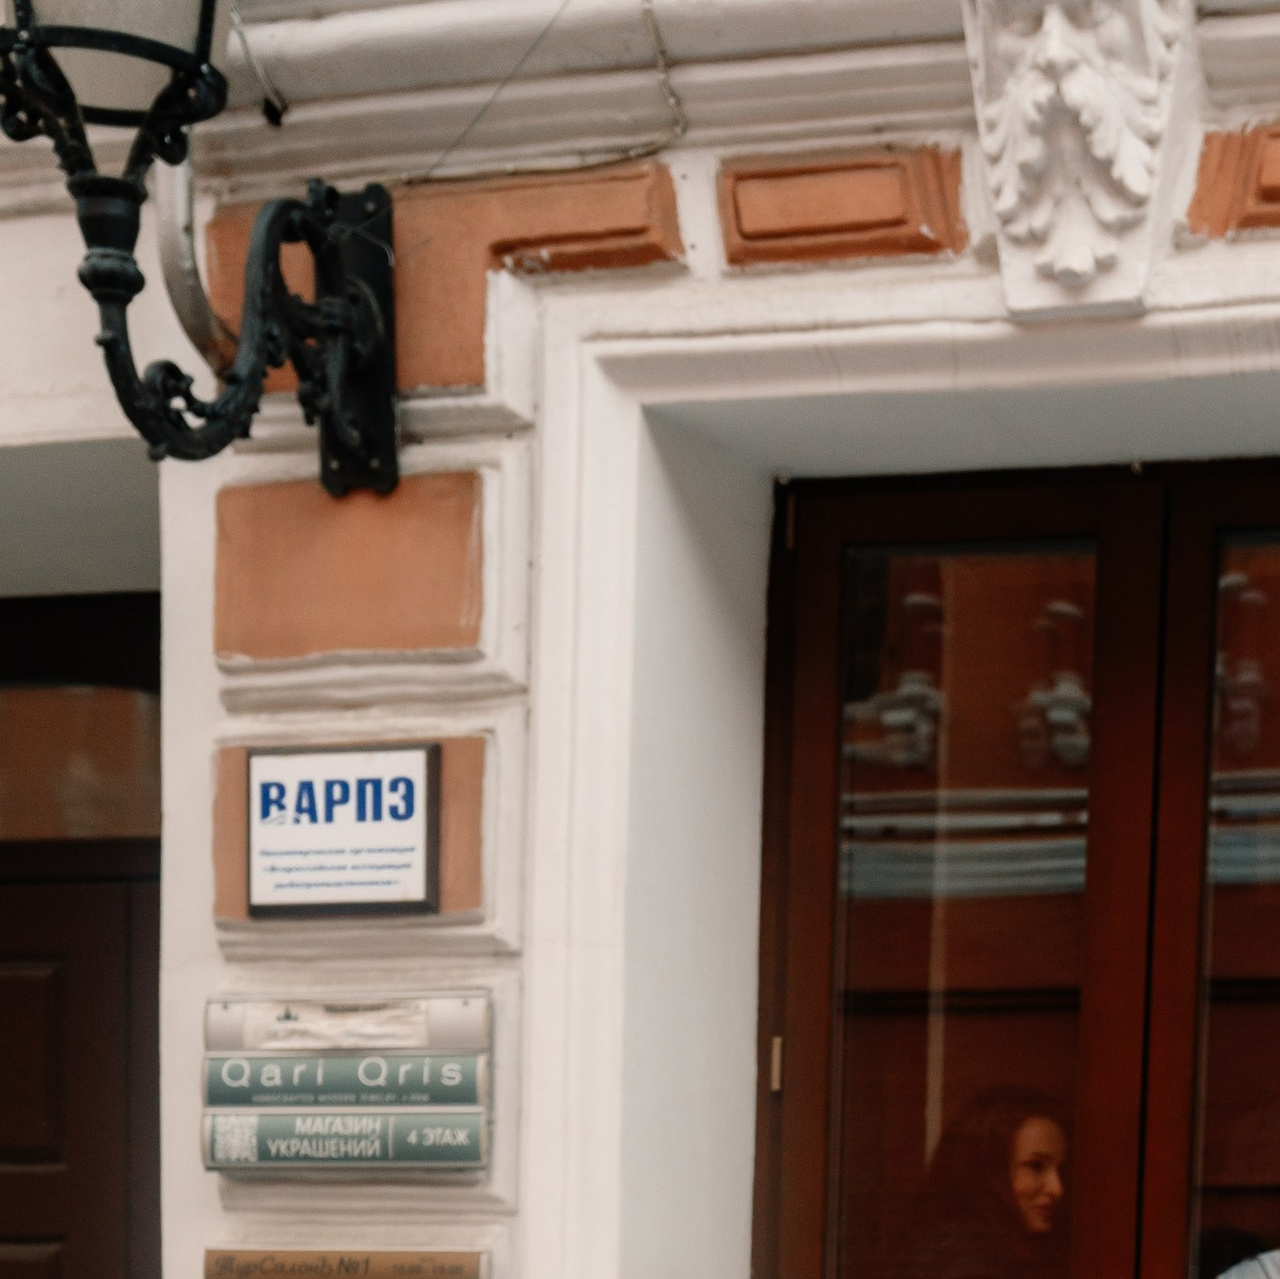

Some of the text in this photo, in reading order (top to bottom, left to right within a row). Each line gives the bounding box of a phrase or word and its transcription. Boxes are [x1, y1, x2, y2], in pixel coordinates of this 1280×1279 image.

[260, 776, 415, 825] ВАРПЭ
[221, 1056, 464, 1088] Qari Qris
[294, 1115, 382, 1136] МАГАЗИН
[406, 1127, 471, 1146] 4 ЭТАЖ
[266, 1135, 381, 1159] УКРАШЕНИЙ
